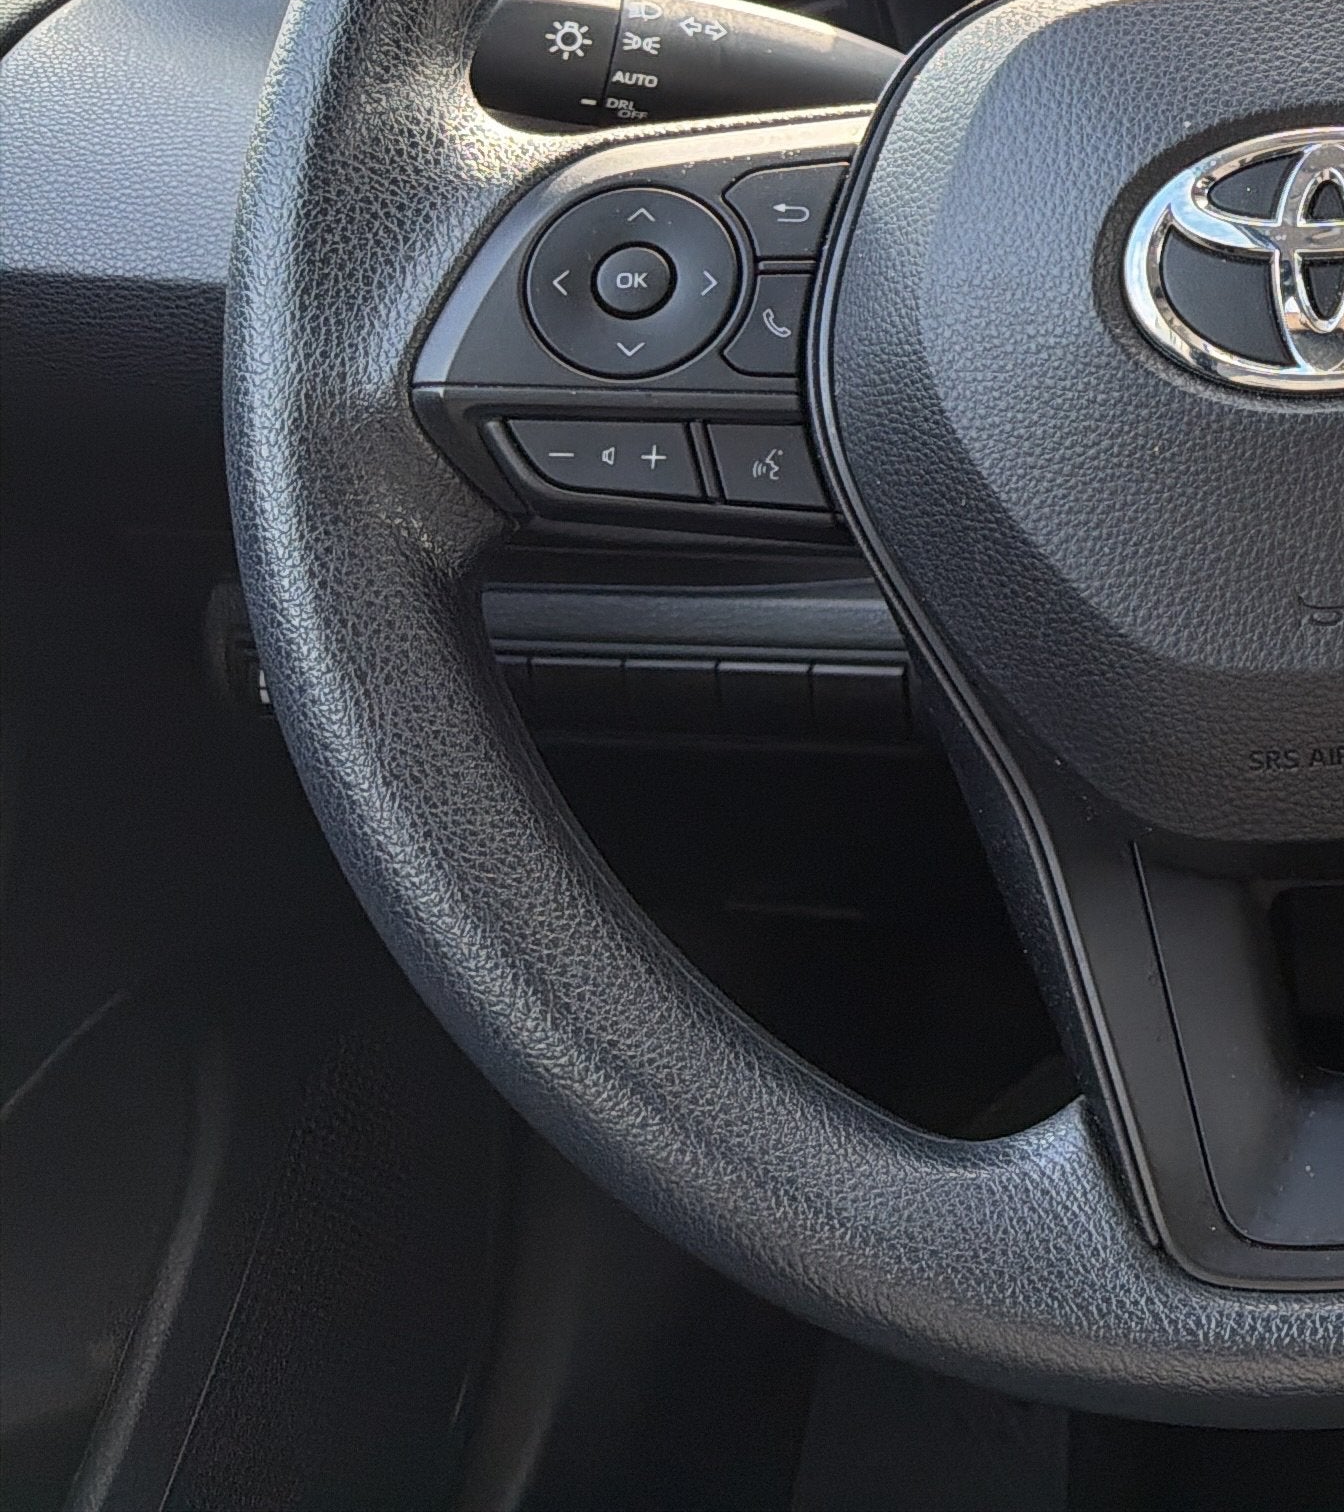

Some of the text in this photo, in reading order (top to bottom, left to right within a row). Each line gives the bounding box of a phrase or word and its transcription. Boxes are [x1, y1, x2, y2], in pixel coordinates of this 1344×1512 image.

[612, 71, 658, 88] AUTO
[606, 98, 635, 111] DRL
[617, 109, 649, 119] OFF
[616, 272, 648, 289] OK
[1250, 749, 1300, 772] SRS
